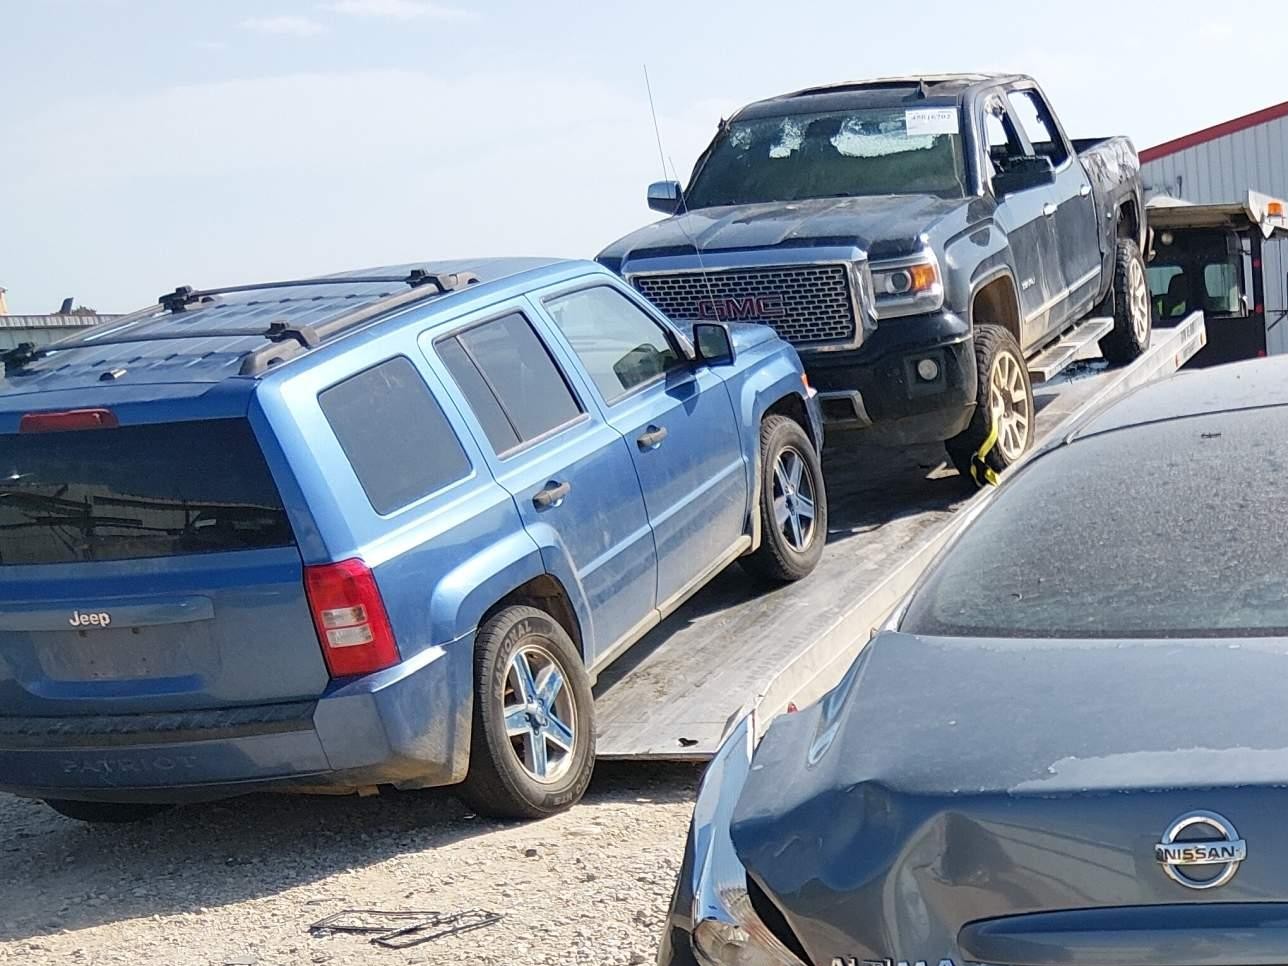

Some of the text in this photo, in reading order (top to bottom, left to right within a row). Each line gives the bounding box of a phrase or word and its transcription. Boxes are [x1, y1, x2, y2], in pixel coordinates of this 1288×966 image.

[699, 295, 786, 320] GMC
[69, 611, 111, 627] Jeep
[63, 755, 198, 773] PATRIOT
[1163, 845, 1235, 861] NISSAN
